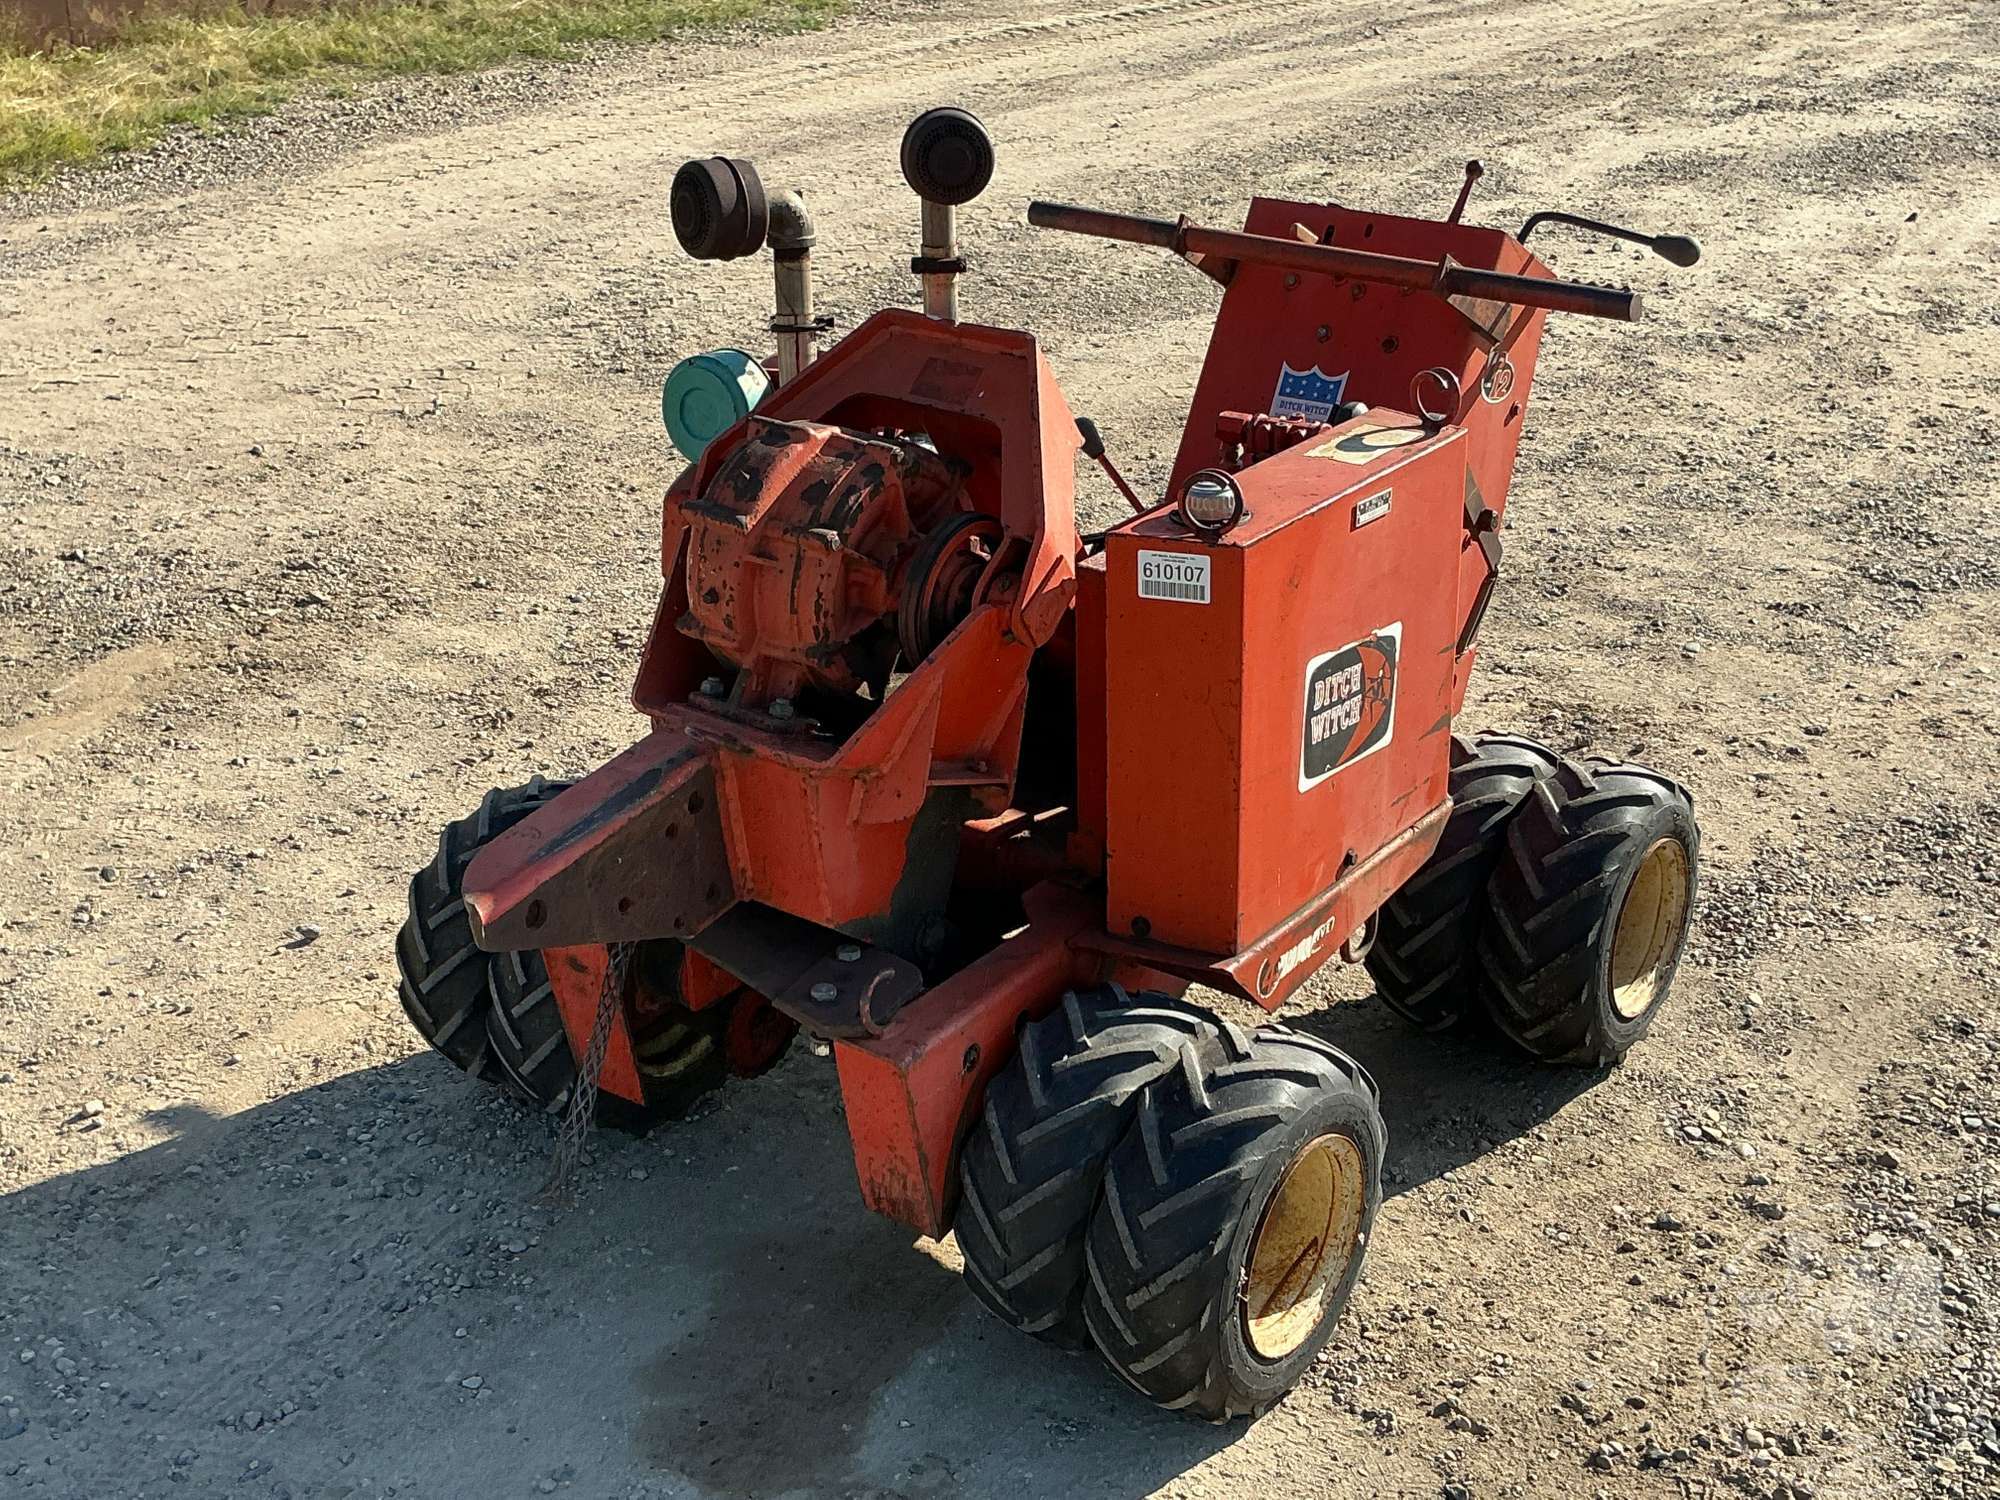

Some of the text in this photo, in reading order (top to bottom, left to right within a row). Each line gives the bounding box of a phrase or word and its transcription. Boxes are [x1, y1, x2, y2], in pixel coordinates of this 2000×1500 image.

[1280, 401, 1329, 415] DITCH WITCH
[1143, 561, 1205, 583] 610107
[1314, 663, 1362, 711] DITCH
[1311, 694, 1362, 744] WITCH
